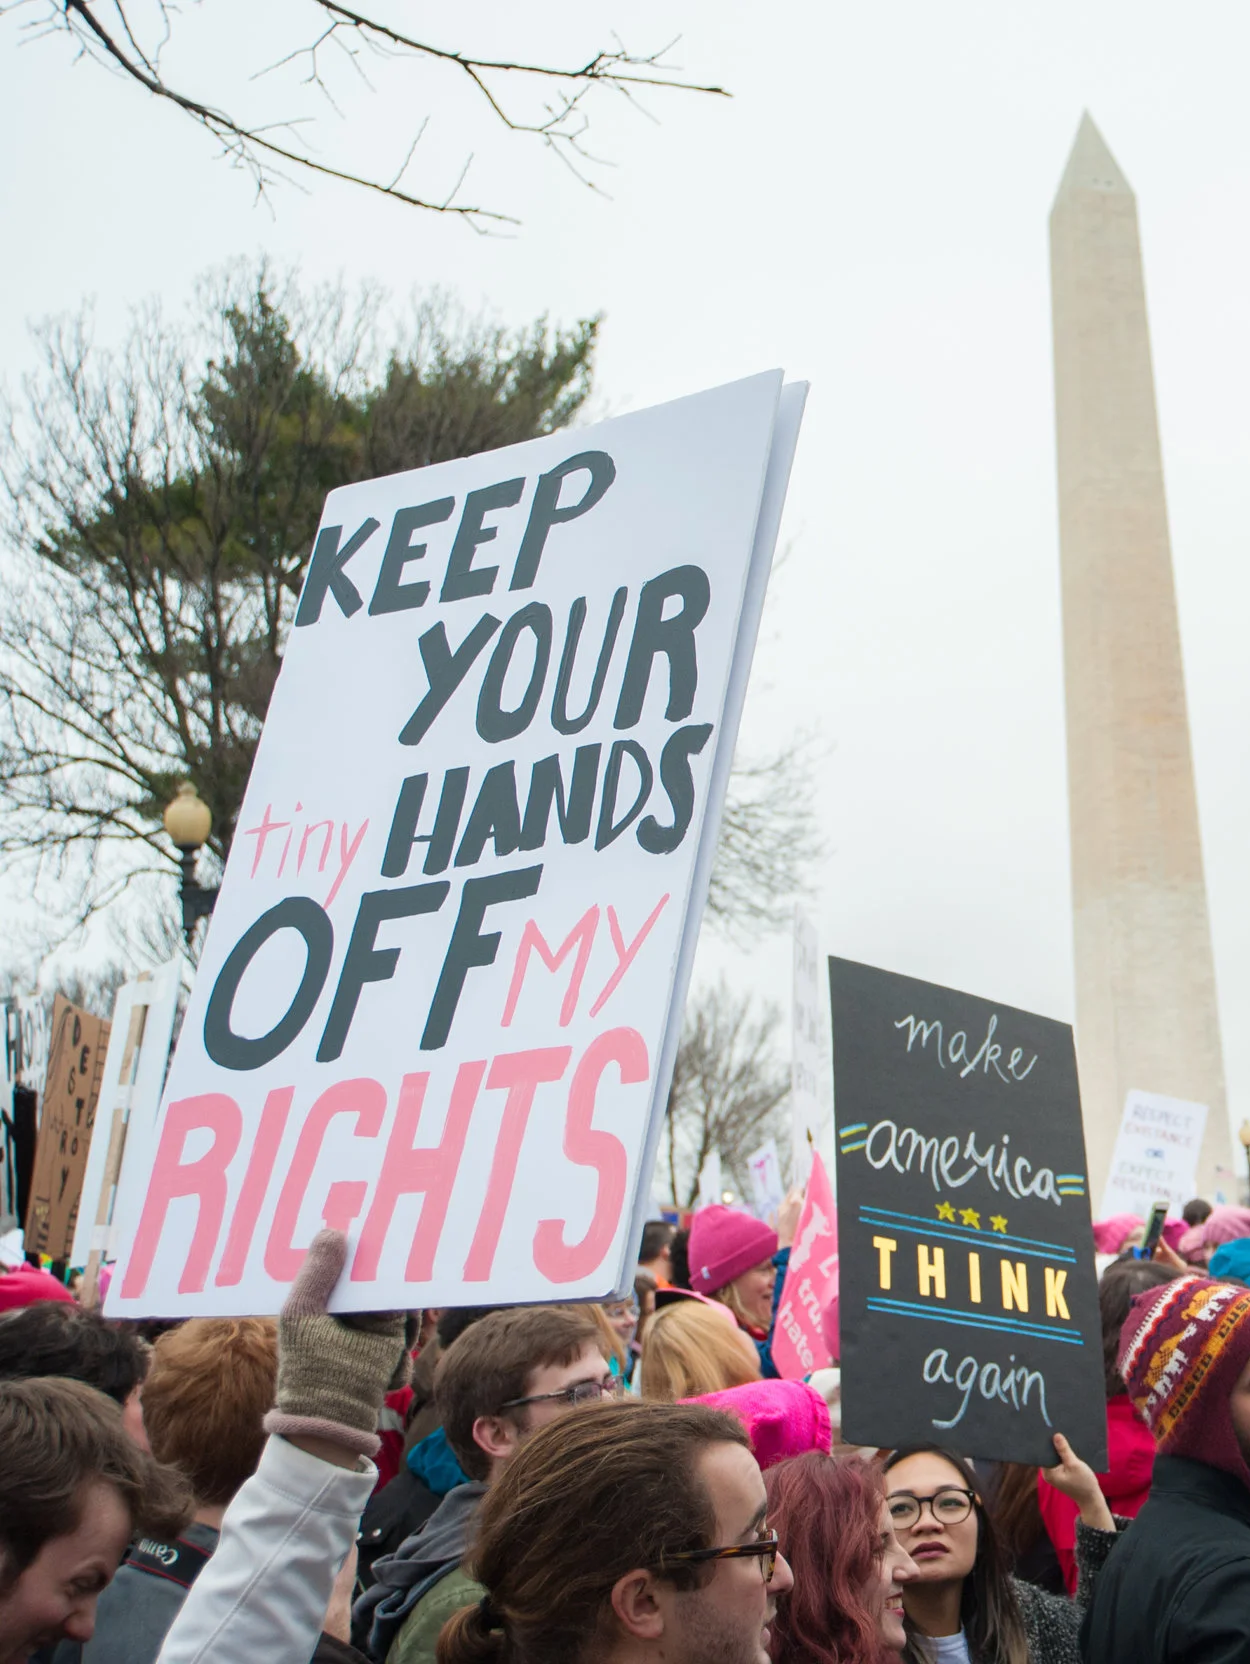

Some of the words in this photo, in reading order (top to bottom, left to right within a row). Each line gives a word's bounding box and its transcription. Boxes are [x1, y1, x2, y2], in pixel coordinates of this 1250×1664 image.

[295, 450, 617, 628] KEEP
[397, 564, 711, 746] YOUR
[244, 802, 369, 908] tiny
[380, 723, 715, 879] HANDS
[202, 864, 544, 1071] OFF
[500, 892, 670, 1028] MY
[894, 1013, 1038, 1083] make
[119, 1025, 651, 1300] RIGHTS
[872, 1235, 1071, 1320] THINK
[922, 1348, 1053, 1429] again
[138, 1538, 179, 1565] Can
